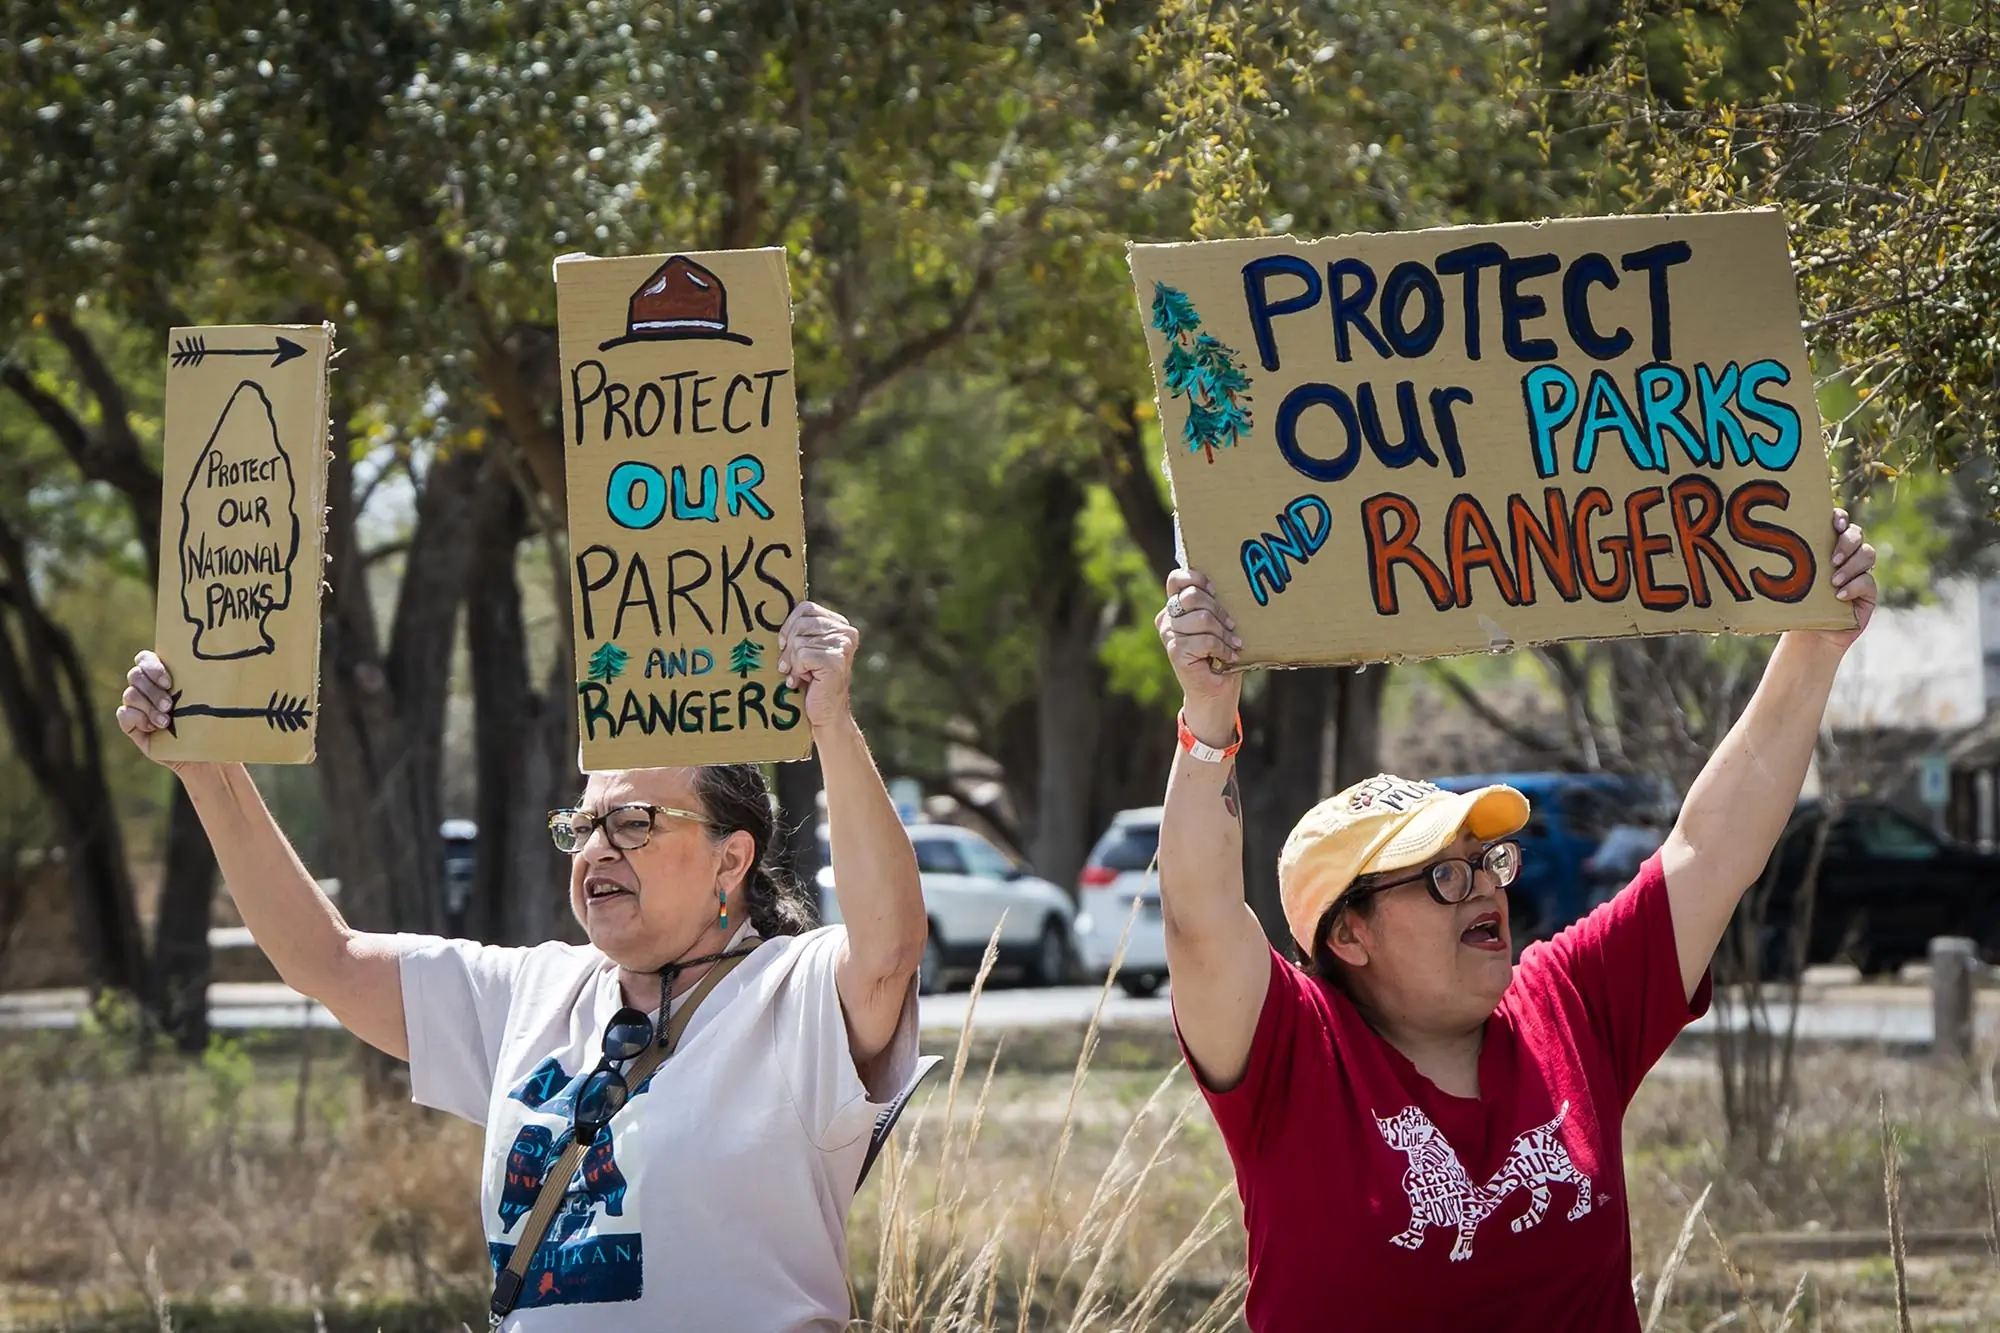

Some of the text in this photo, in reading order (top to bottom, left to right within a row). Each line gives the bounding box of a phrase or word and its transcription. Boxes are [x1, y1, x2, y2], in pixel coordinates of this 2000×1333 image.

[1242, 241, 1691, 370] PROTECT
[572, 360, 790, 445] PROTECT
[1523, 359, 1801, 478] PARKS
[206, 450, 281, 489] PROTECT
[607, 454, 774, 530] OUR
[217, 497, 271, 528] OUR
[1240, 474, 1816, 614] AND RANGERS
[188, 532, 286, 584] NATIONAL
[576, 537, 796, 640] PARKS
[206, 582, 273, 629] PARKS
[645, 648, 714, 677] AND
[578, 681, 800, 740] RANGERS
